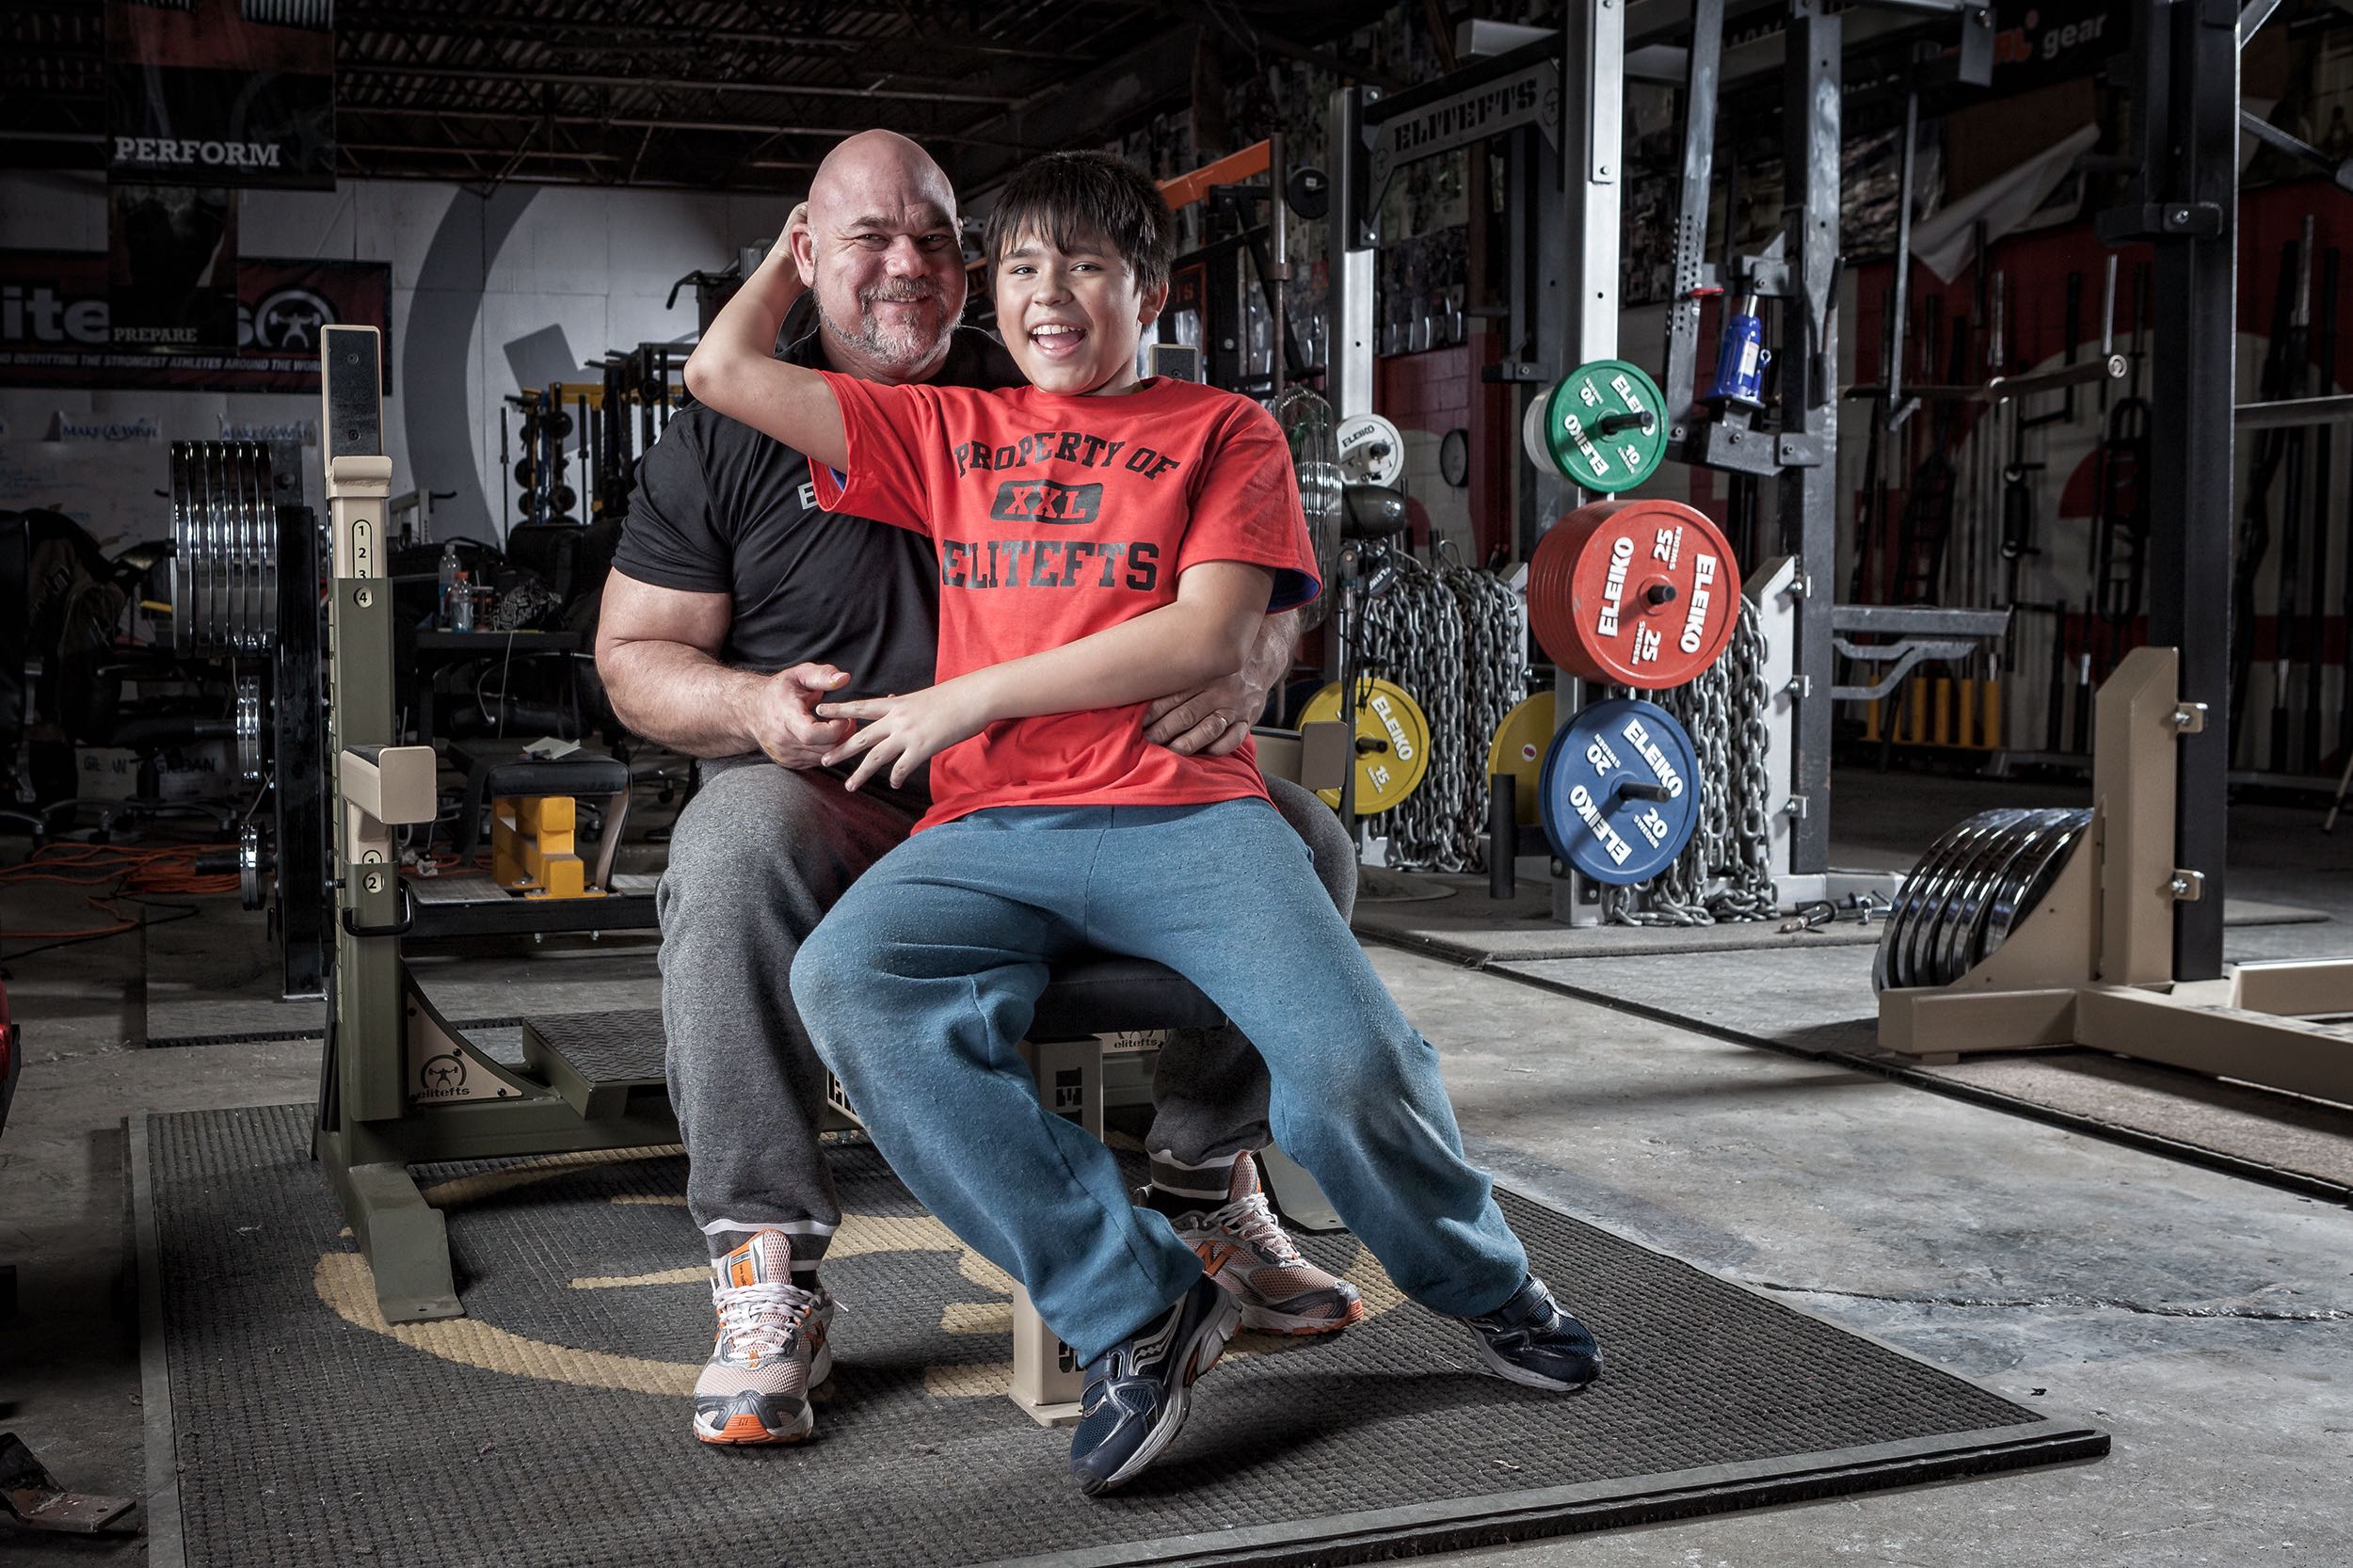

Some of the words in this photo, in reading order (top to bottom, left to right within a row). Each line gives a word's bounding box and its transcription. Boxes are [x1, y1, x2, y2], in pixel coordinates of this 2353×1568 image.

[2041, 13, 2108, 60] gear
[1395, 77, 1538, 152] ELITEFTS
[114, 136, 280, 167] PERFORM
[113, 327, 198, 344] PREPARE
[168, 356, 222, 370] ATHLETES
[223, 358, 270, 371] AROUND
[271, 359, 294, 372] THE
[1580, 386, 1597, 408] 10
[1341, 424, 1375, 448] ELEIKO
[1564, 414, 1609, 477] ELEIKO
[954, 431, 1127, 478] PROPERTY
[1125, 447, 1180, 480] OF
[1625, 443, 1641, 465] 10
[1004, 486, 1086, 519] XXL
[359, 525, 364, 536] 1
[1653, 528, 1673, 563] 25
[359, 547, 366, 558] 2
[942, 538, 1160, 591] ELITEFTS
[1668, 525, 1683, 571] SWEDEN
[359, 592, 368, 603] 4
[1598, 536, 1635, 637] ELEIKO
[1680, 553, 1717, 654] ELEIKO
[1641, 629, 1661, 662] 25
[1370, 696, 1413, 760] ELEIKO
[1586, 744, 1612, 776] 20
[1594, 733, 1622, 769] SWEDEN
[1623, 718, 1684, 798] ELEIKO
[1374, 765, 1390, 784] 15
[1570, 784, 1633, 866] ELEIKO
[1632, 814, 1660, 849] SWEDEN
[1642, 808, 1668, 840] 20
[368, 877, 377, 889] 2
[1114, 1038, 1159, 1048] elitefts
[421, 1087, 471, 1099] elitefts
